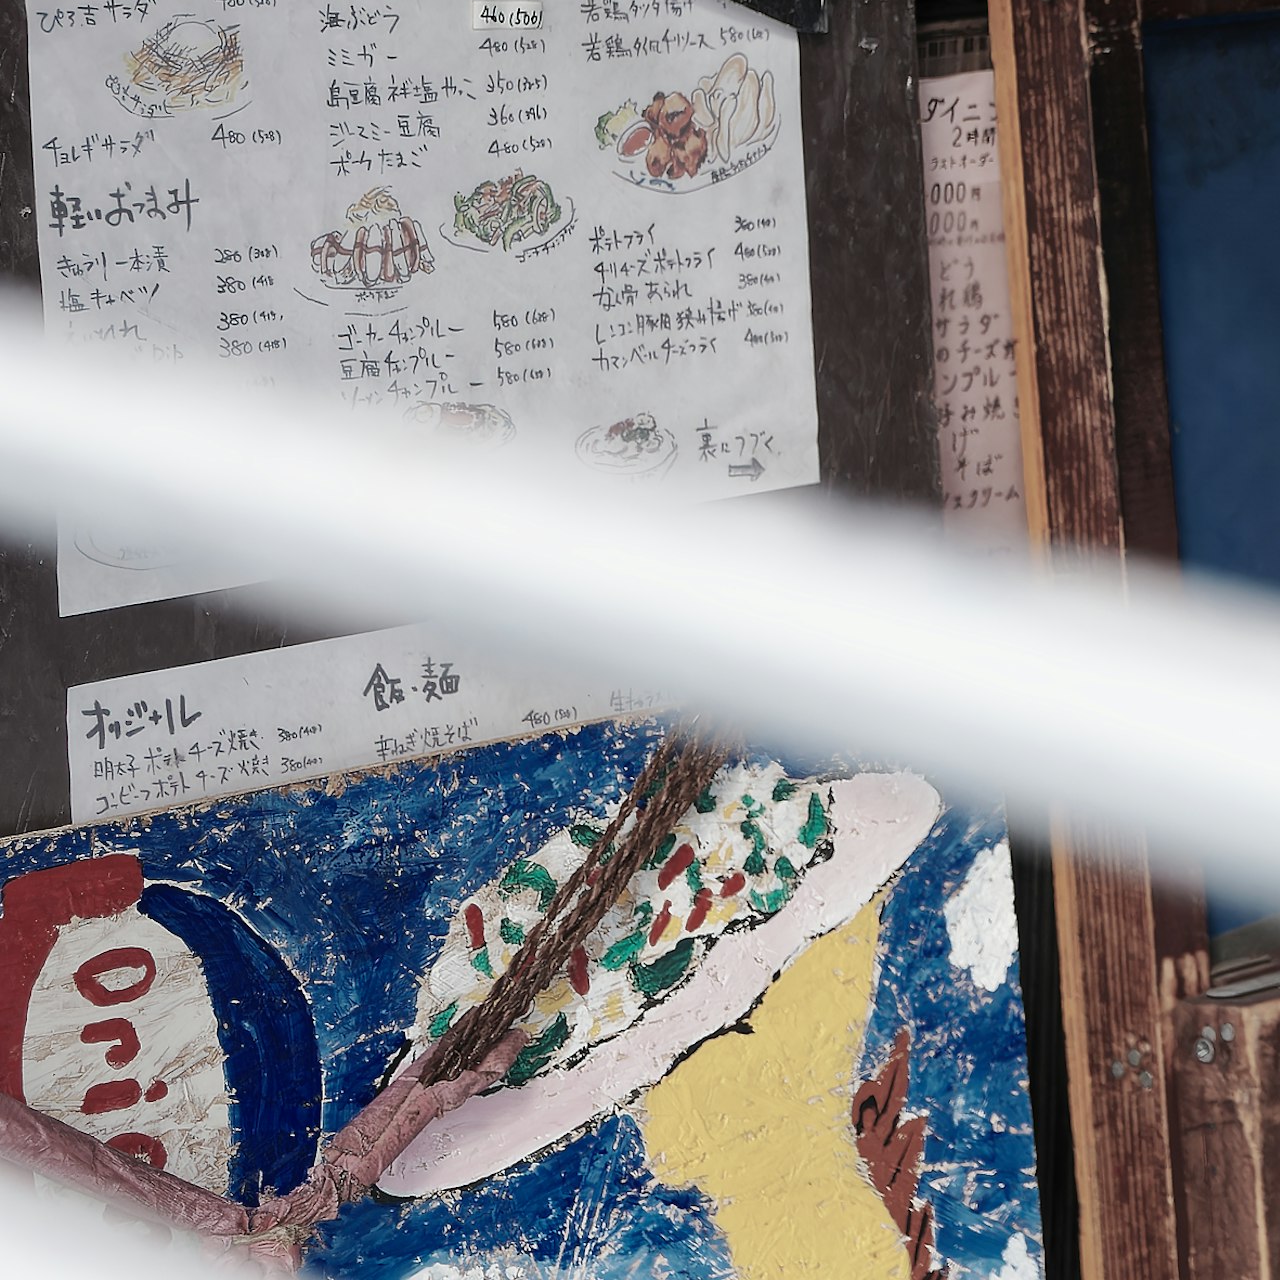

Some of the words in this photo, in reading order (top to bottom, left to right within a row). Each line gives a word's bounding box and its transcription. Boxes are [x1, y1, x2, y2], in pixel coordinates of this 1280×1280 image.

[318, 4, 400, 34] 海ぶどう
[328, 42, 398, 68] ミミガー
[49, 178, 200, 237] 軽いおつまみ
[589, 222, 656, 255] ポテトフライ
